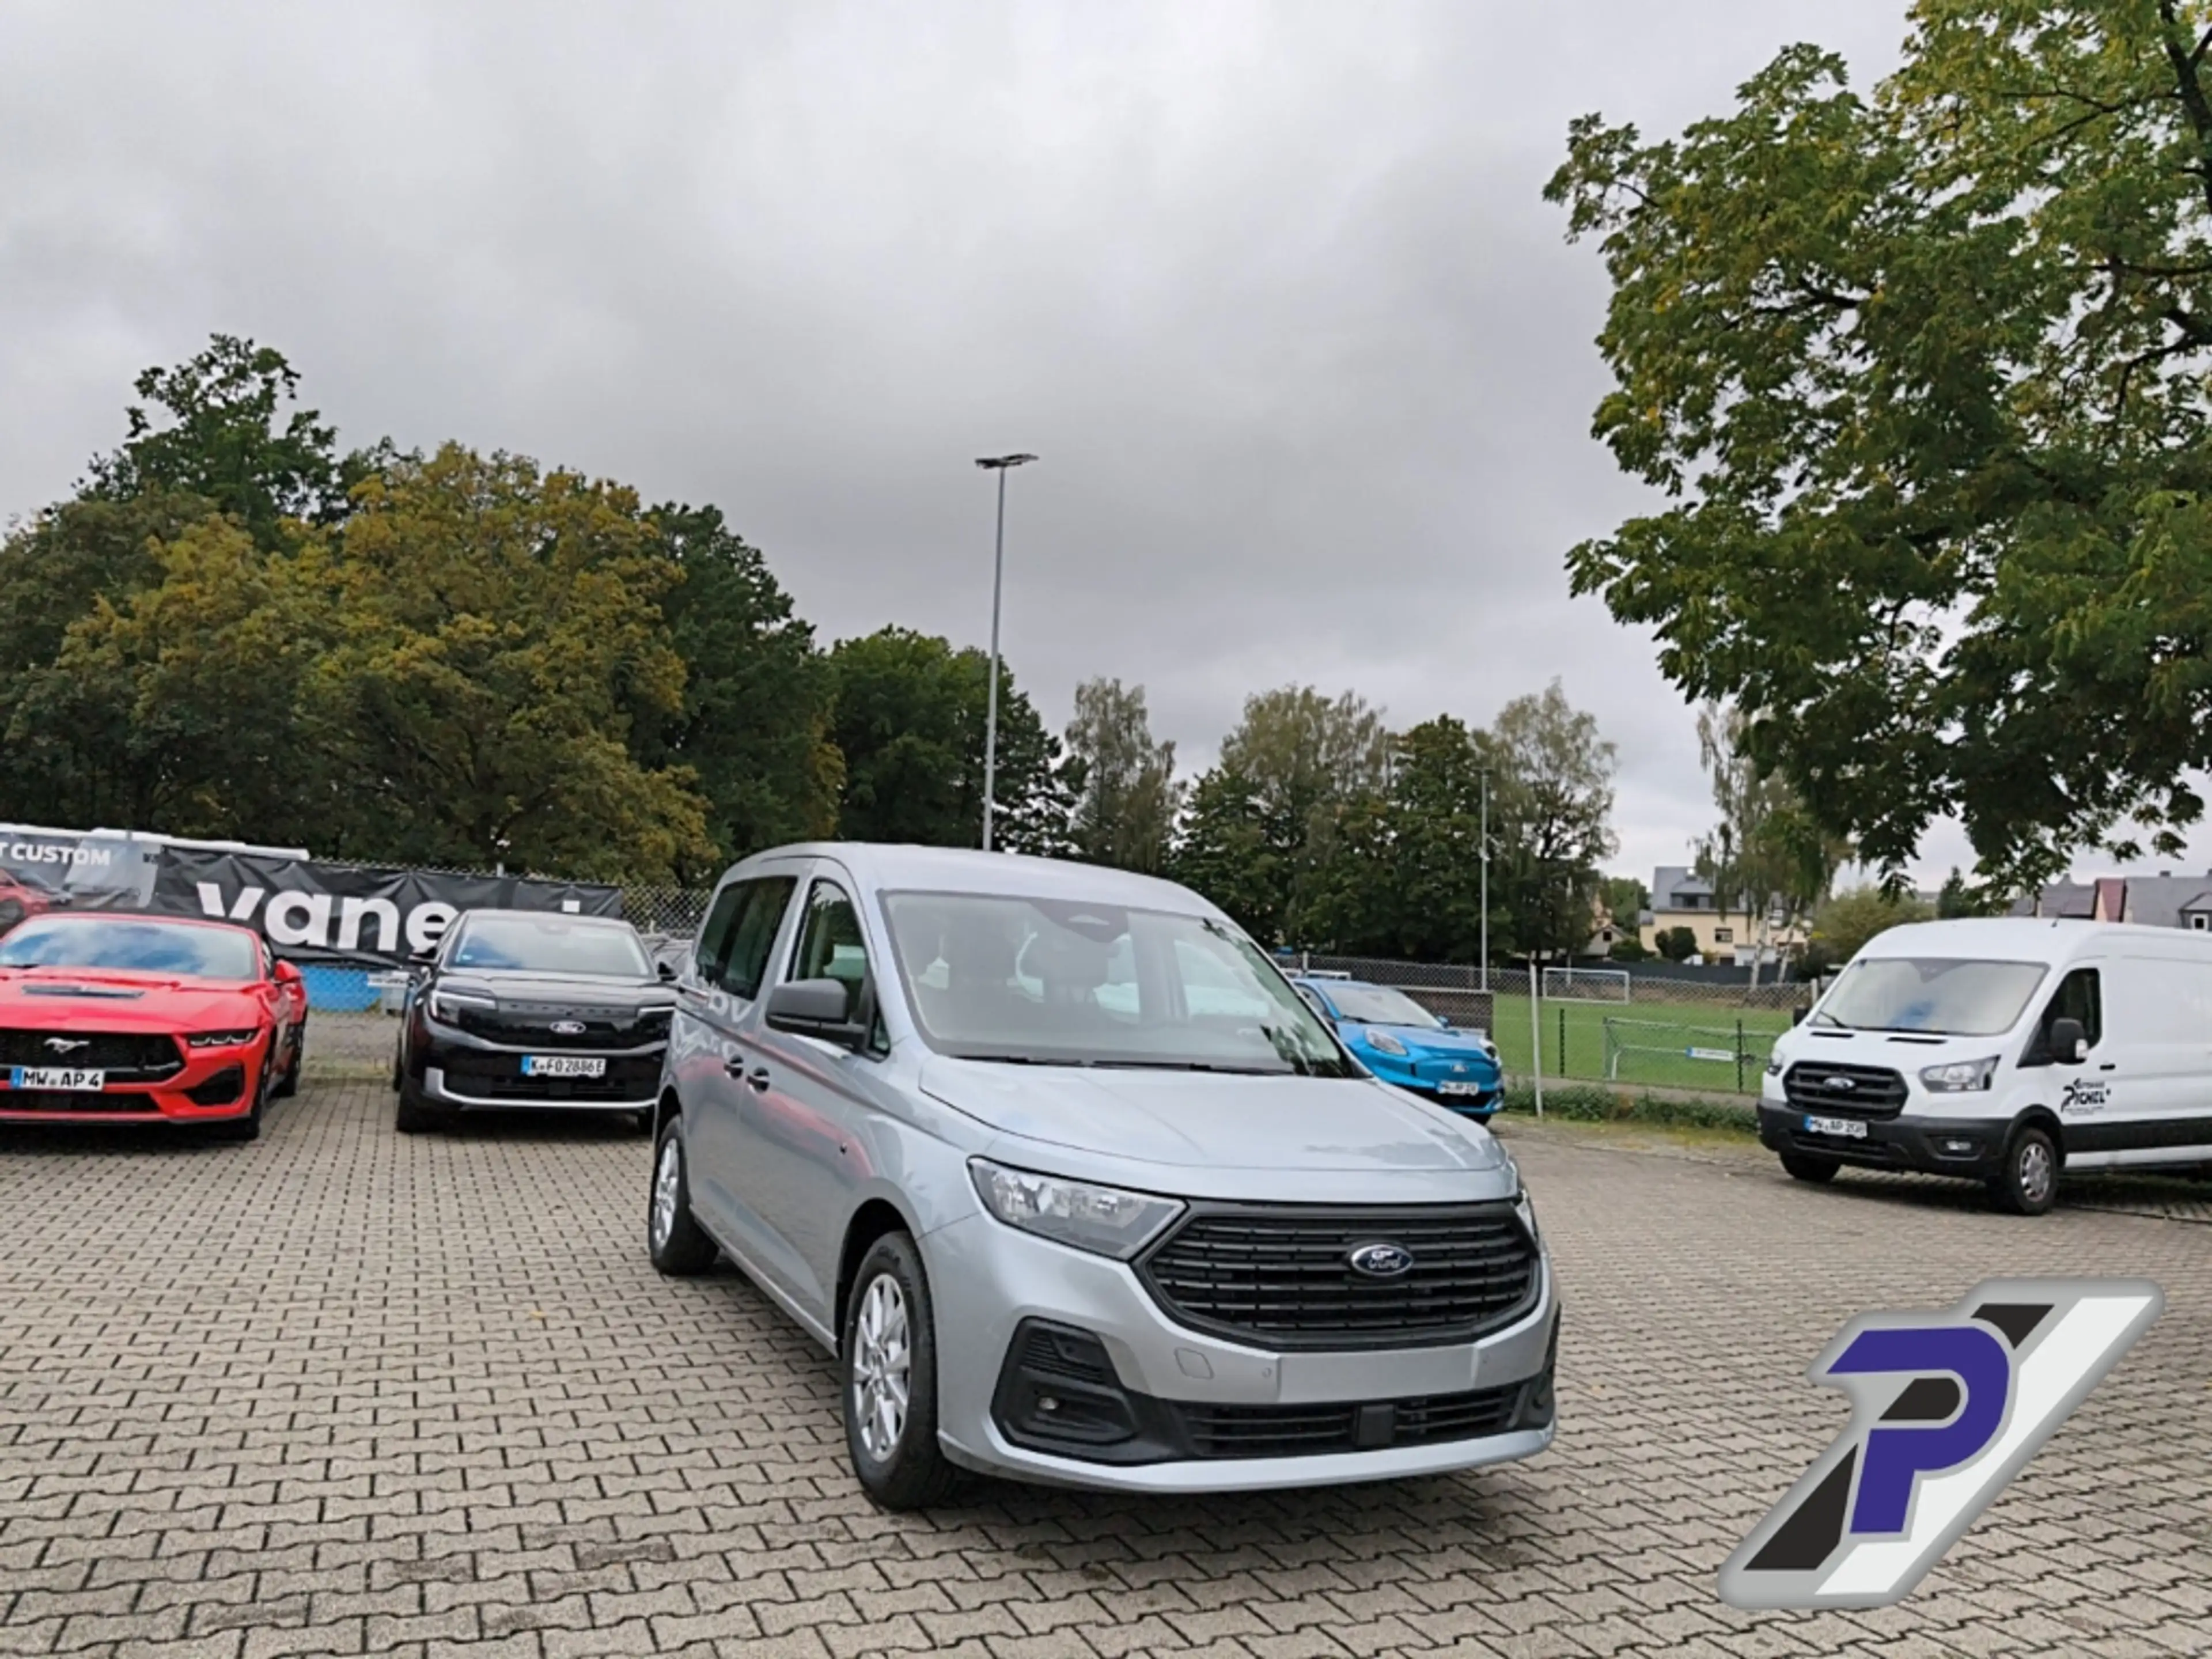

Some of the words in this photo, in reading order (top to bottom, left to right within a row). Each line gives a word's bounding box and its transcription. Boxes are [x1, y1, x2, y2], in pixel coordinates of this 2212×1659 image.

[10, 842, 111, 865] CUSTOM
[196, 881, 459, 953] vane
[24, 1070, 48, 1085] MW
